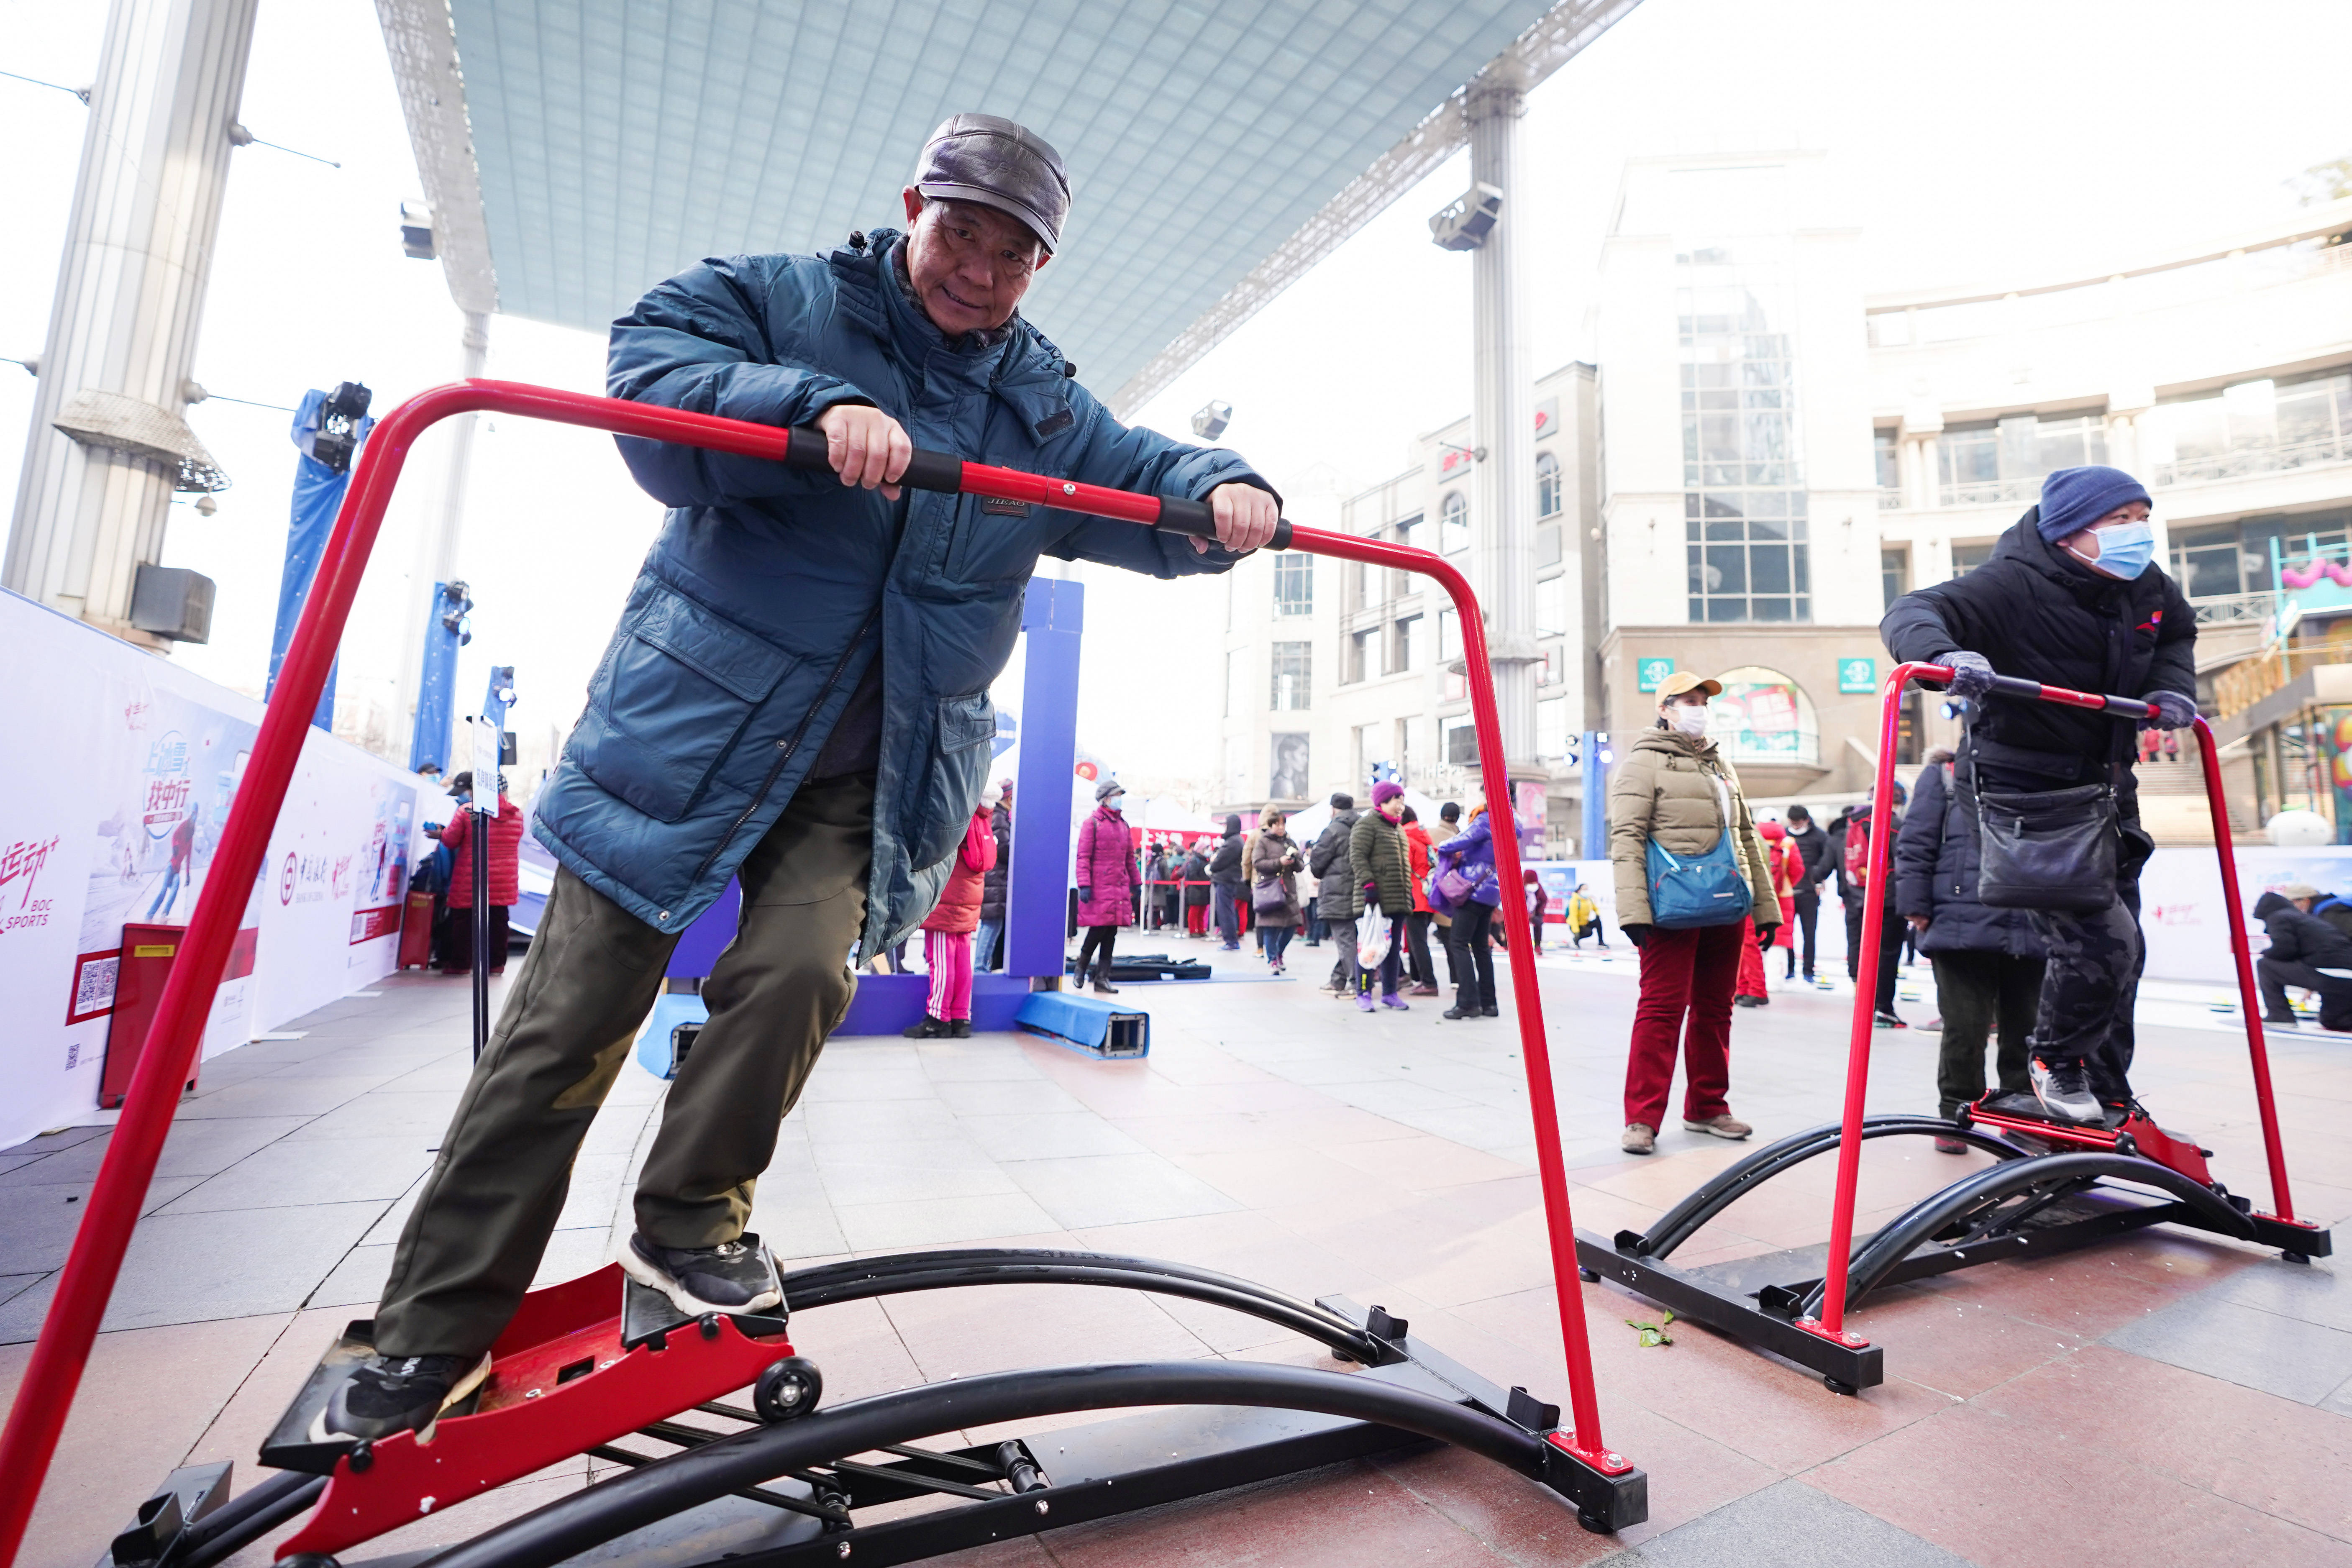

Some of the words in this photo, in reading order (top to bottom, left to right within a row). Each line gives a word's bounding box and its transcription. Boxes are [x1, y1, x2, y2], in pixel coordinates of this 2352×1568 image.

[142, 742, 187, 777] 上冰雪
[477, 767, 496, 792] 热身体验区
[146, 779, 191, 811] 找中行
[31, 899, 53, 912] BOC
[5, 914, 49, 929] SPORTS
